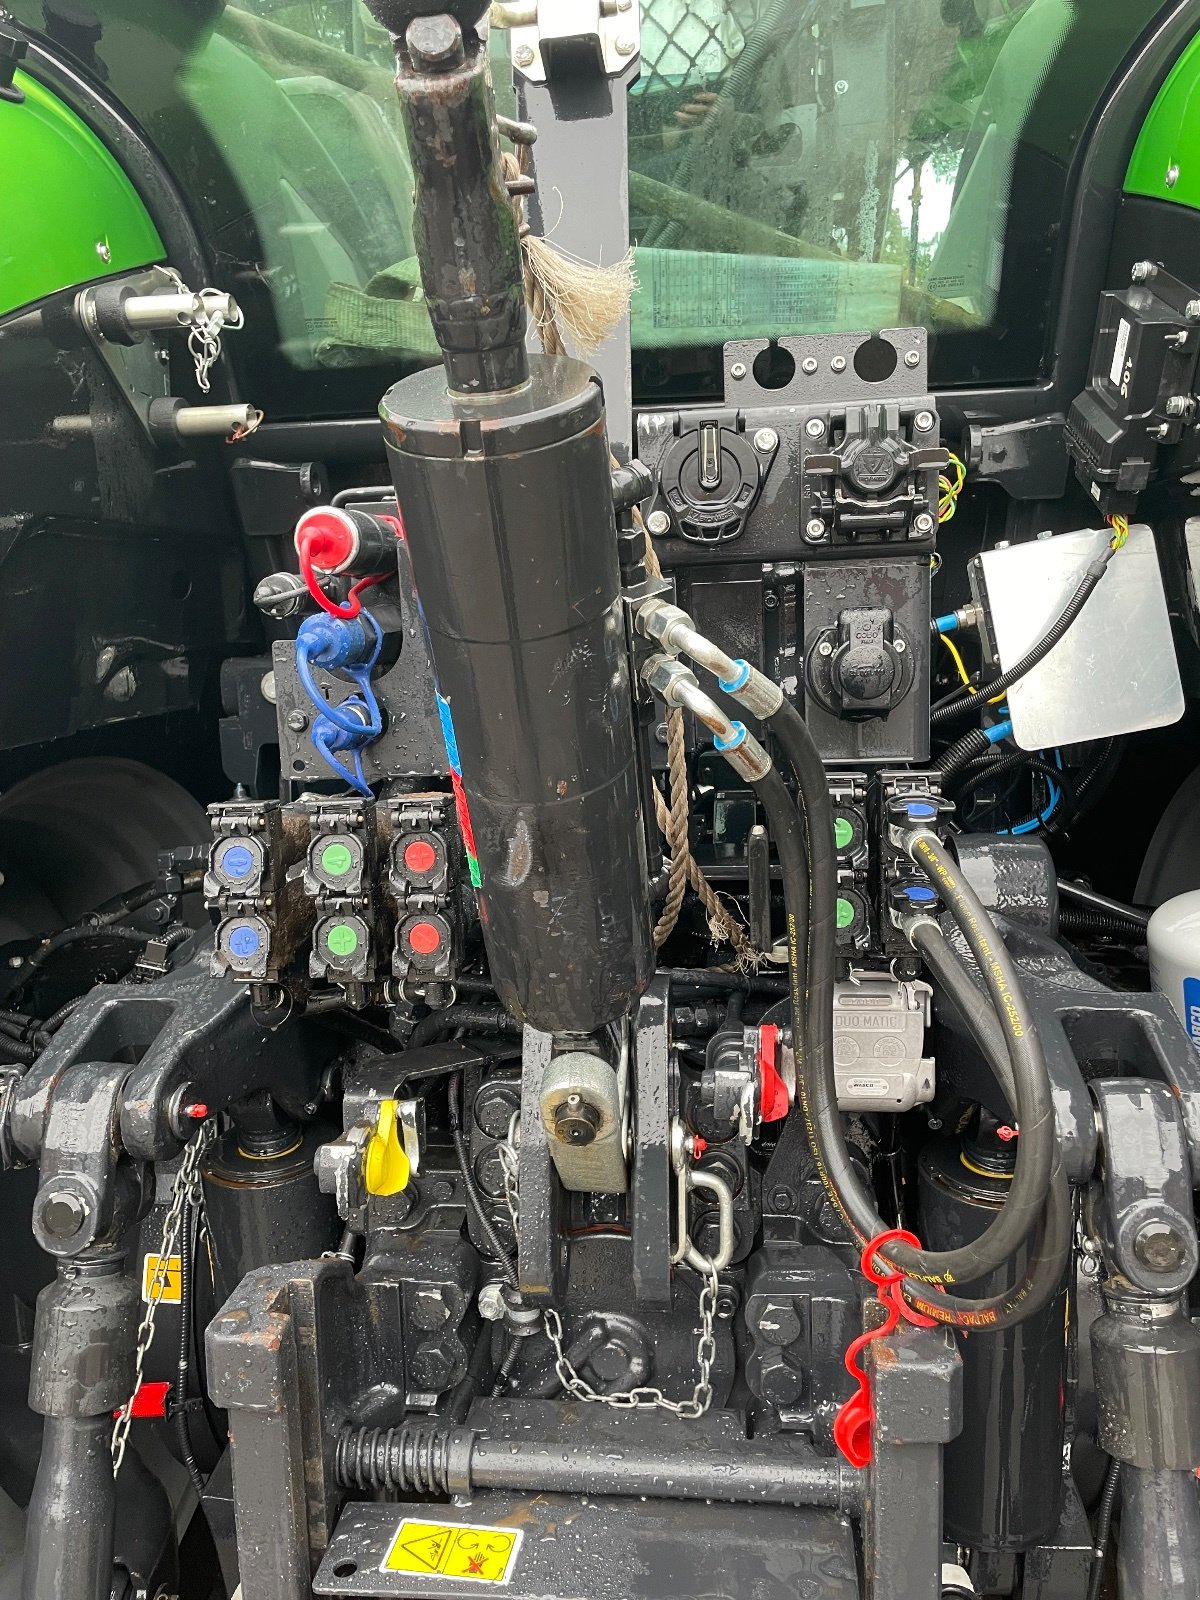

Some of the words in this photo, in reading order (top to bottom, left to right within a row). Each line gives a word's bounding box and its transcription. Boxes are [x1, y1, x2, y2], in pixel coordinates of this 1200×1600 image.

[790, 945, 798, 968] MSHA
[968, 917, 992, 957] Resistant
[990, 961, 1008, 991] MSHA
[1002, 991, 1024, 1038] IC-252/00
[835, 1015, 860, 1028] DUO
[863, 1015, 897, 1028] MATIC
